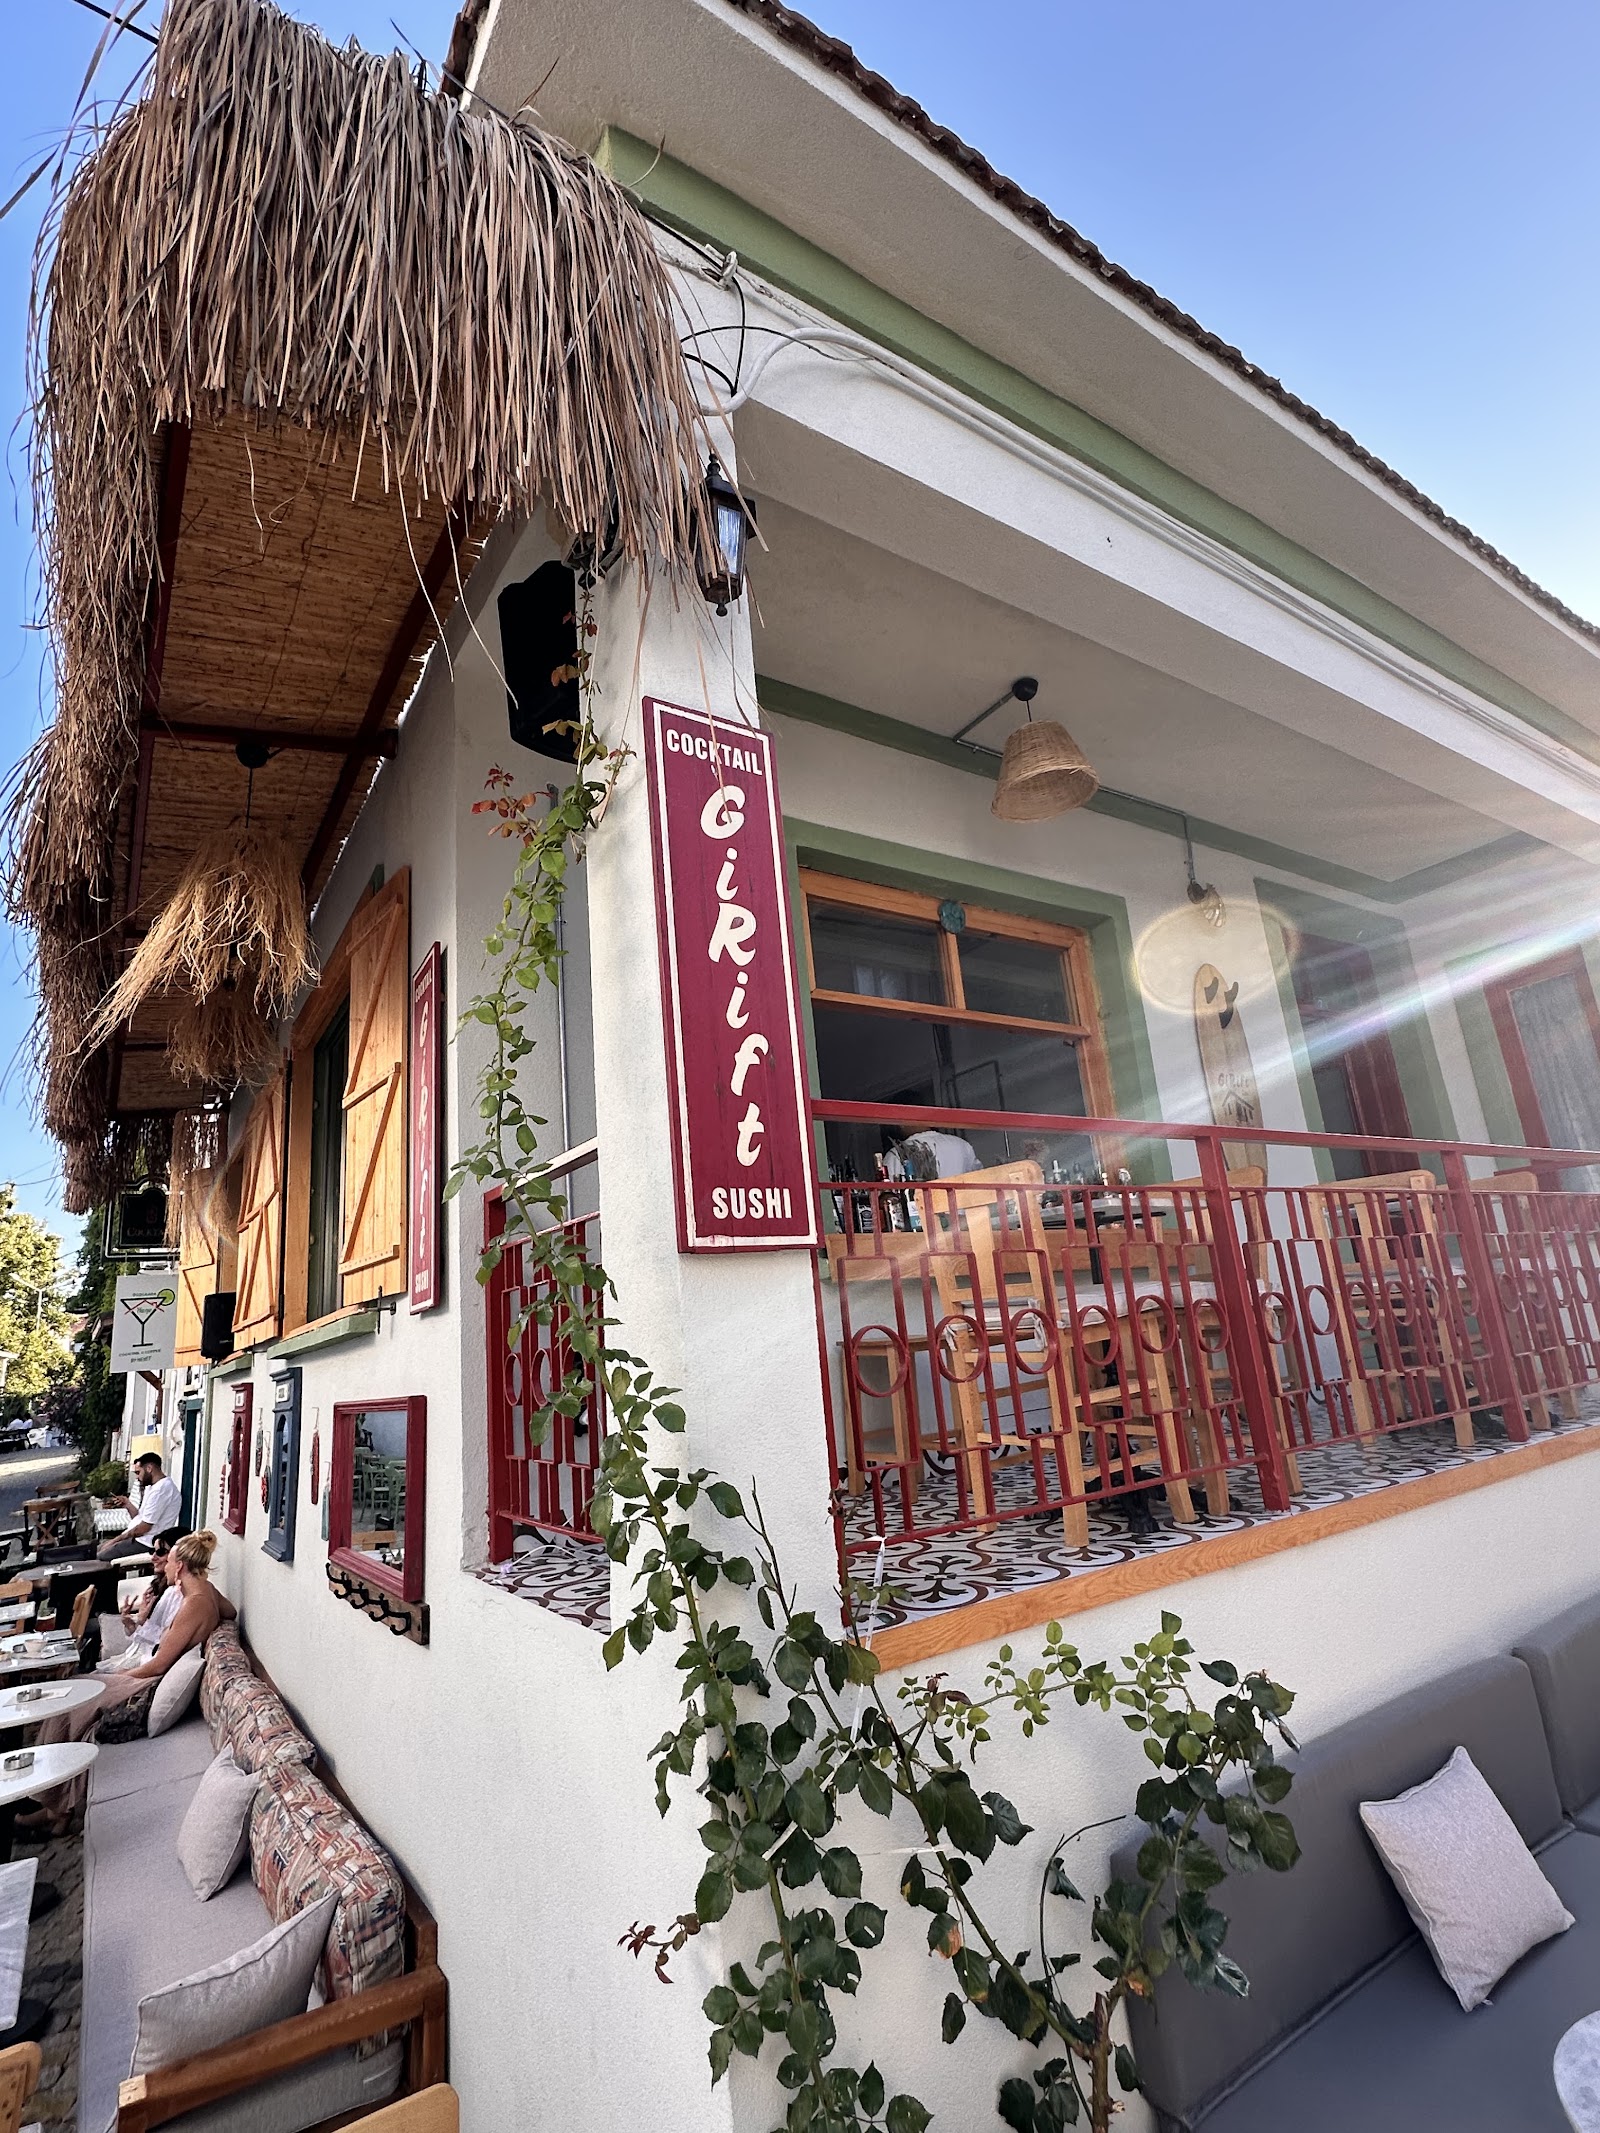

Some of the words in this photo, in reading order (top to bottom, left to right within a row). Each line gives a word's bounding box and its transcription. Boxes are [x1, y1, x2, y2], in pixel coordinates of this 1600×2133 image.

[666, 728, 763, 777] COCKTAIL
[711, 1186, 792, 1221] SUSHI
[415, 1269, 429, 1294] SUSHI
